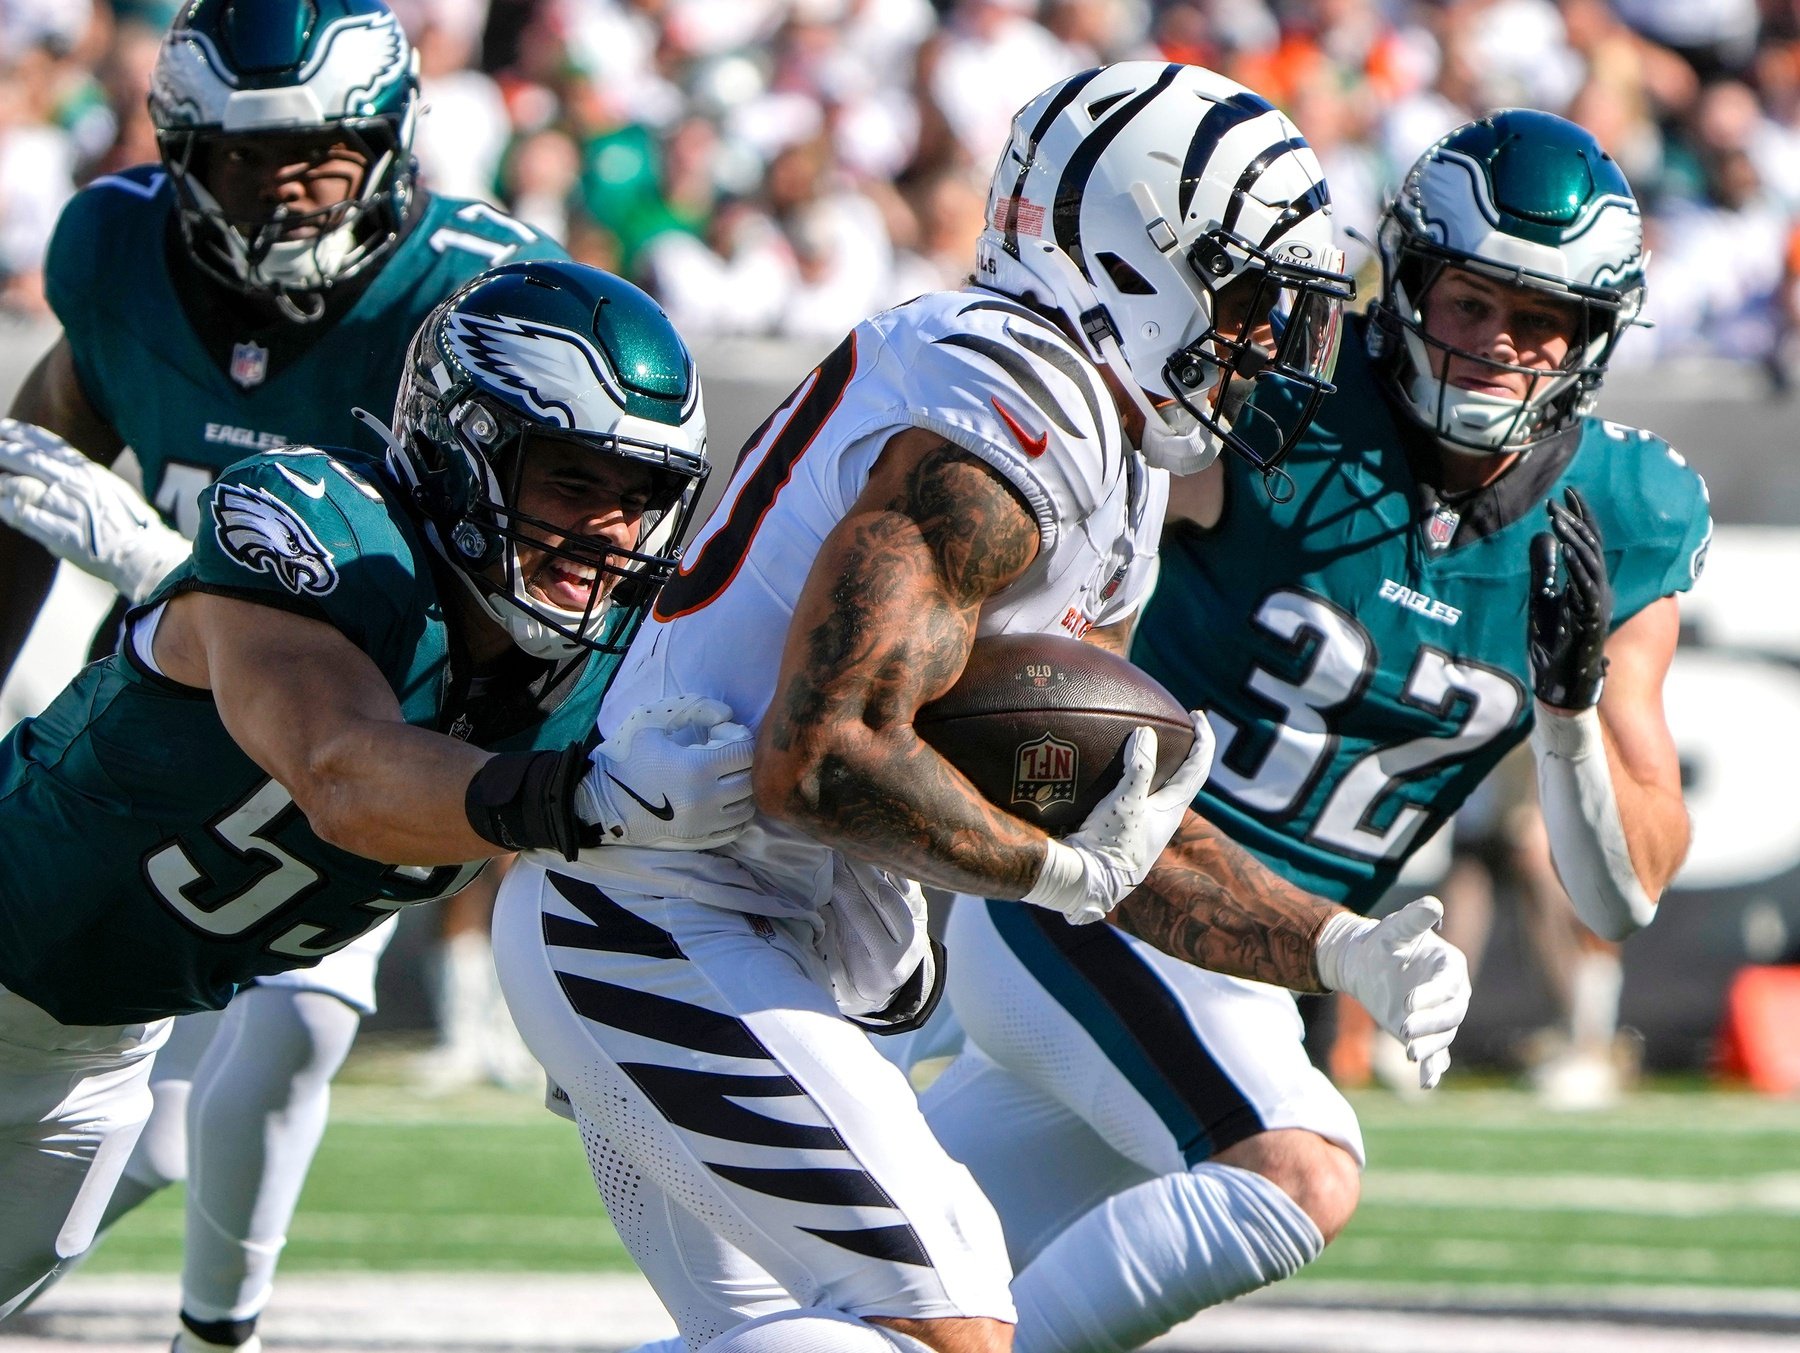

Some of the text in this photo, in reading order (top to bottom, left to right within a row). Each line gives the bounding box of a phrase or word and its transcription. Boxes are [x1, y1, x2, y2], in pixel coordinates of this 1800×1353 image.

[1379, 578, 1463, 627] EAGLES
[1026, 664, 1052, 678] 078
[1203, 590, 1520, 860] 32
[1022, 744, 1073, 780] NFL
